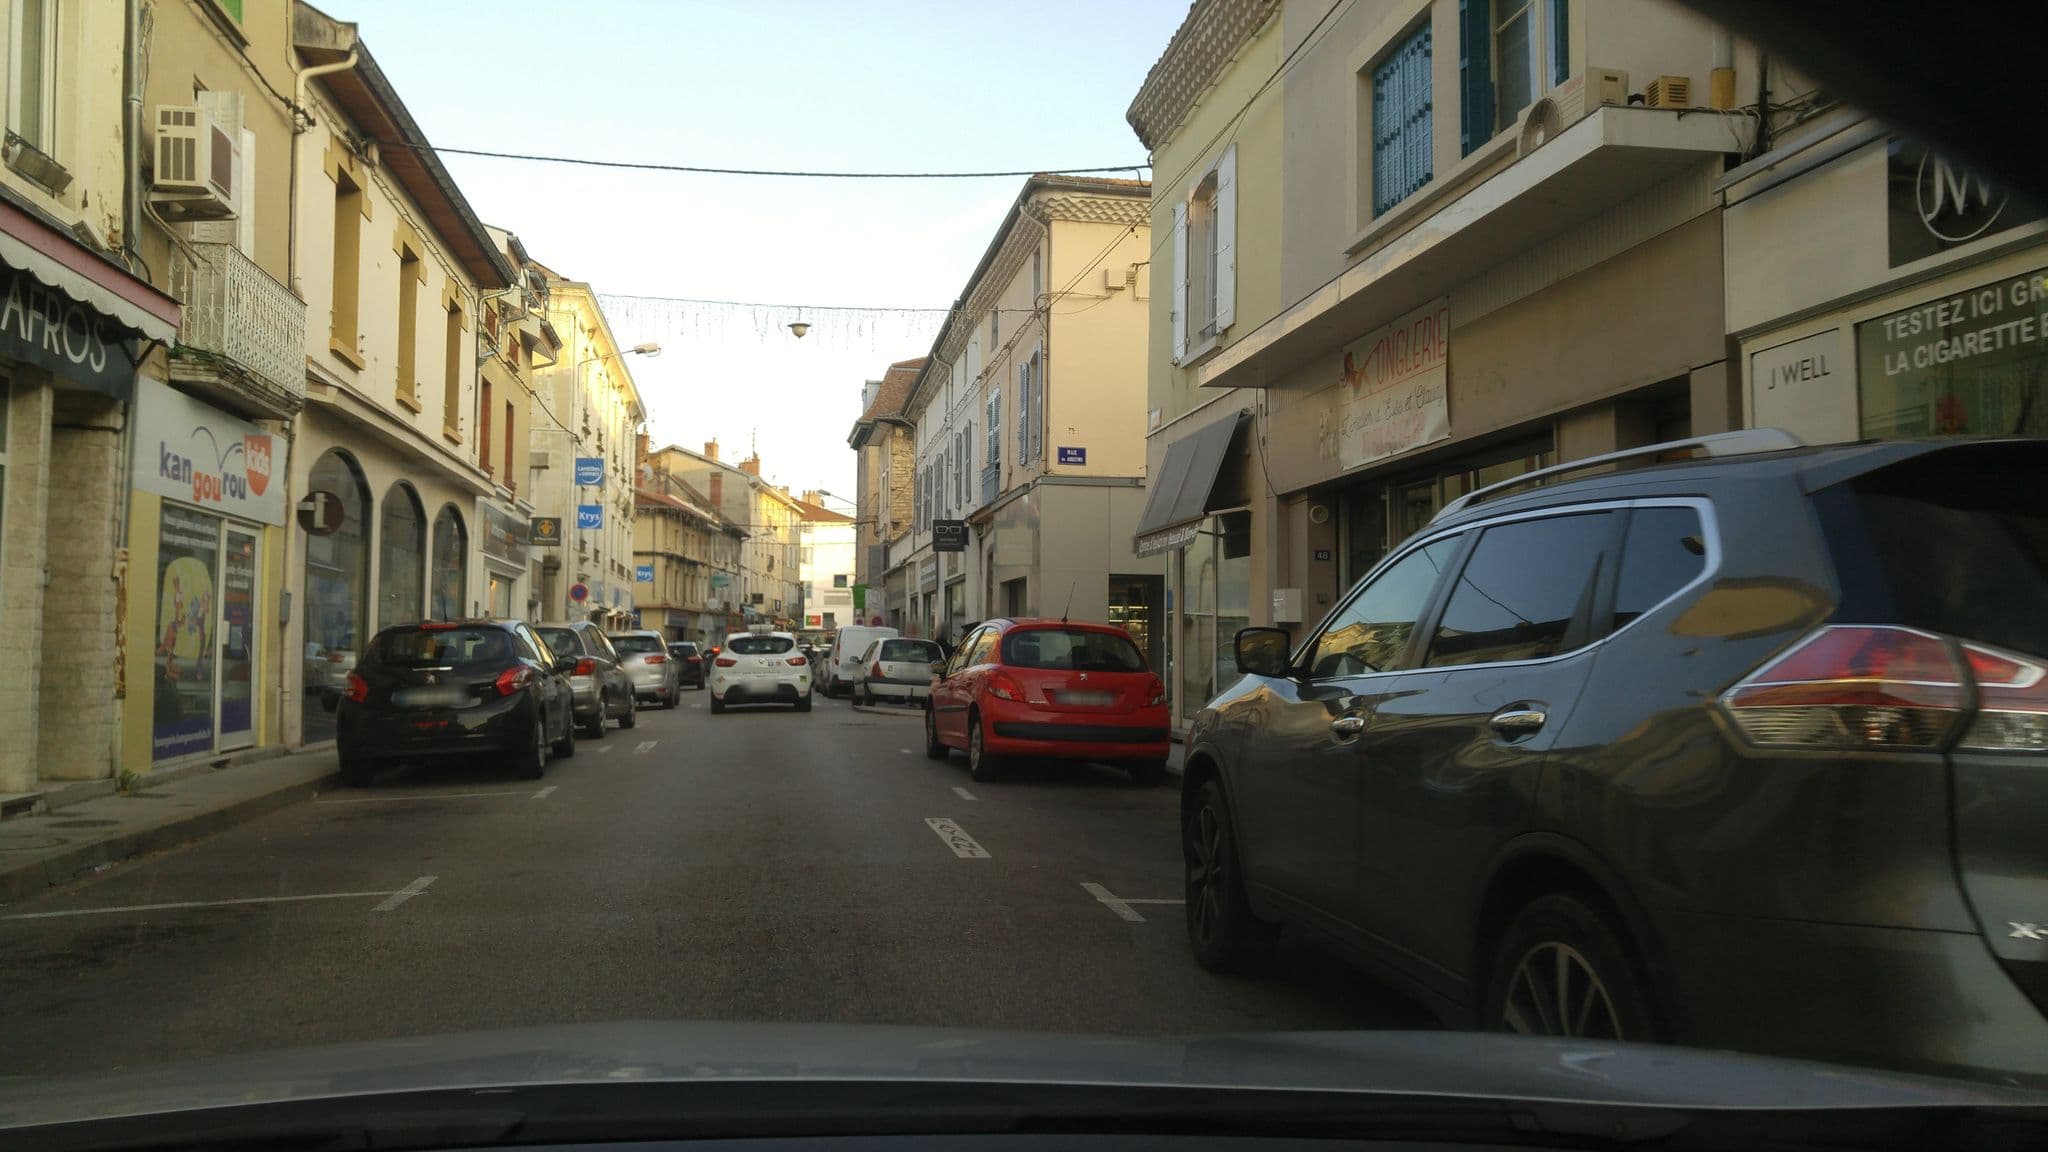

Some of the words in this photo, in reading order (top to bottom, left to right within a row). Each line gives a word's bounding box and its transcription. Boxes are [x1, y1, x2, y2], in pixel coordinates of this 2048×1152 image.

[1, 275, 106, 373] AFROS
[1883, 298, 1966, 342] TESTEZ
[1972, 290, 2003, 318] ICI
[1376, 307, 1448, 385] ONGLERIE
[1767, 367, 1776, 390] J
[1782, 353, 1831, 384] WELL
[1884, 354, 1911, 377] LA
[1914, 317, 2036, 370] CIGARETTE
[579, 511, 600, 523] Krys
